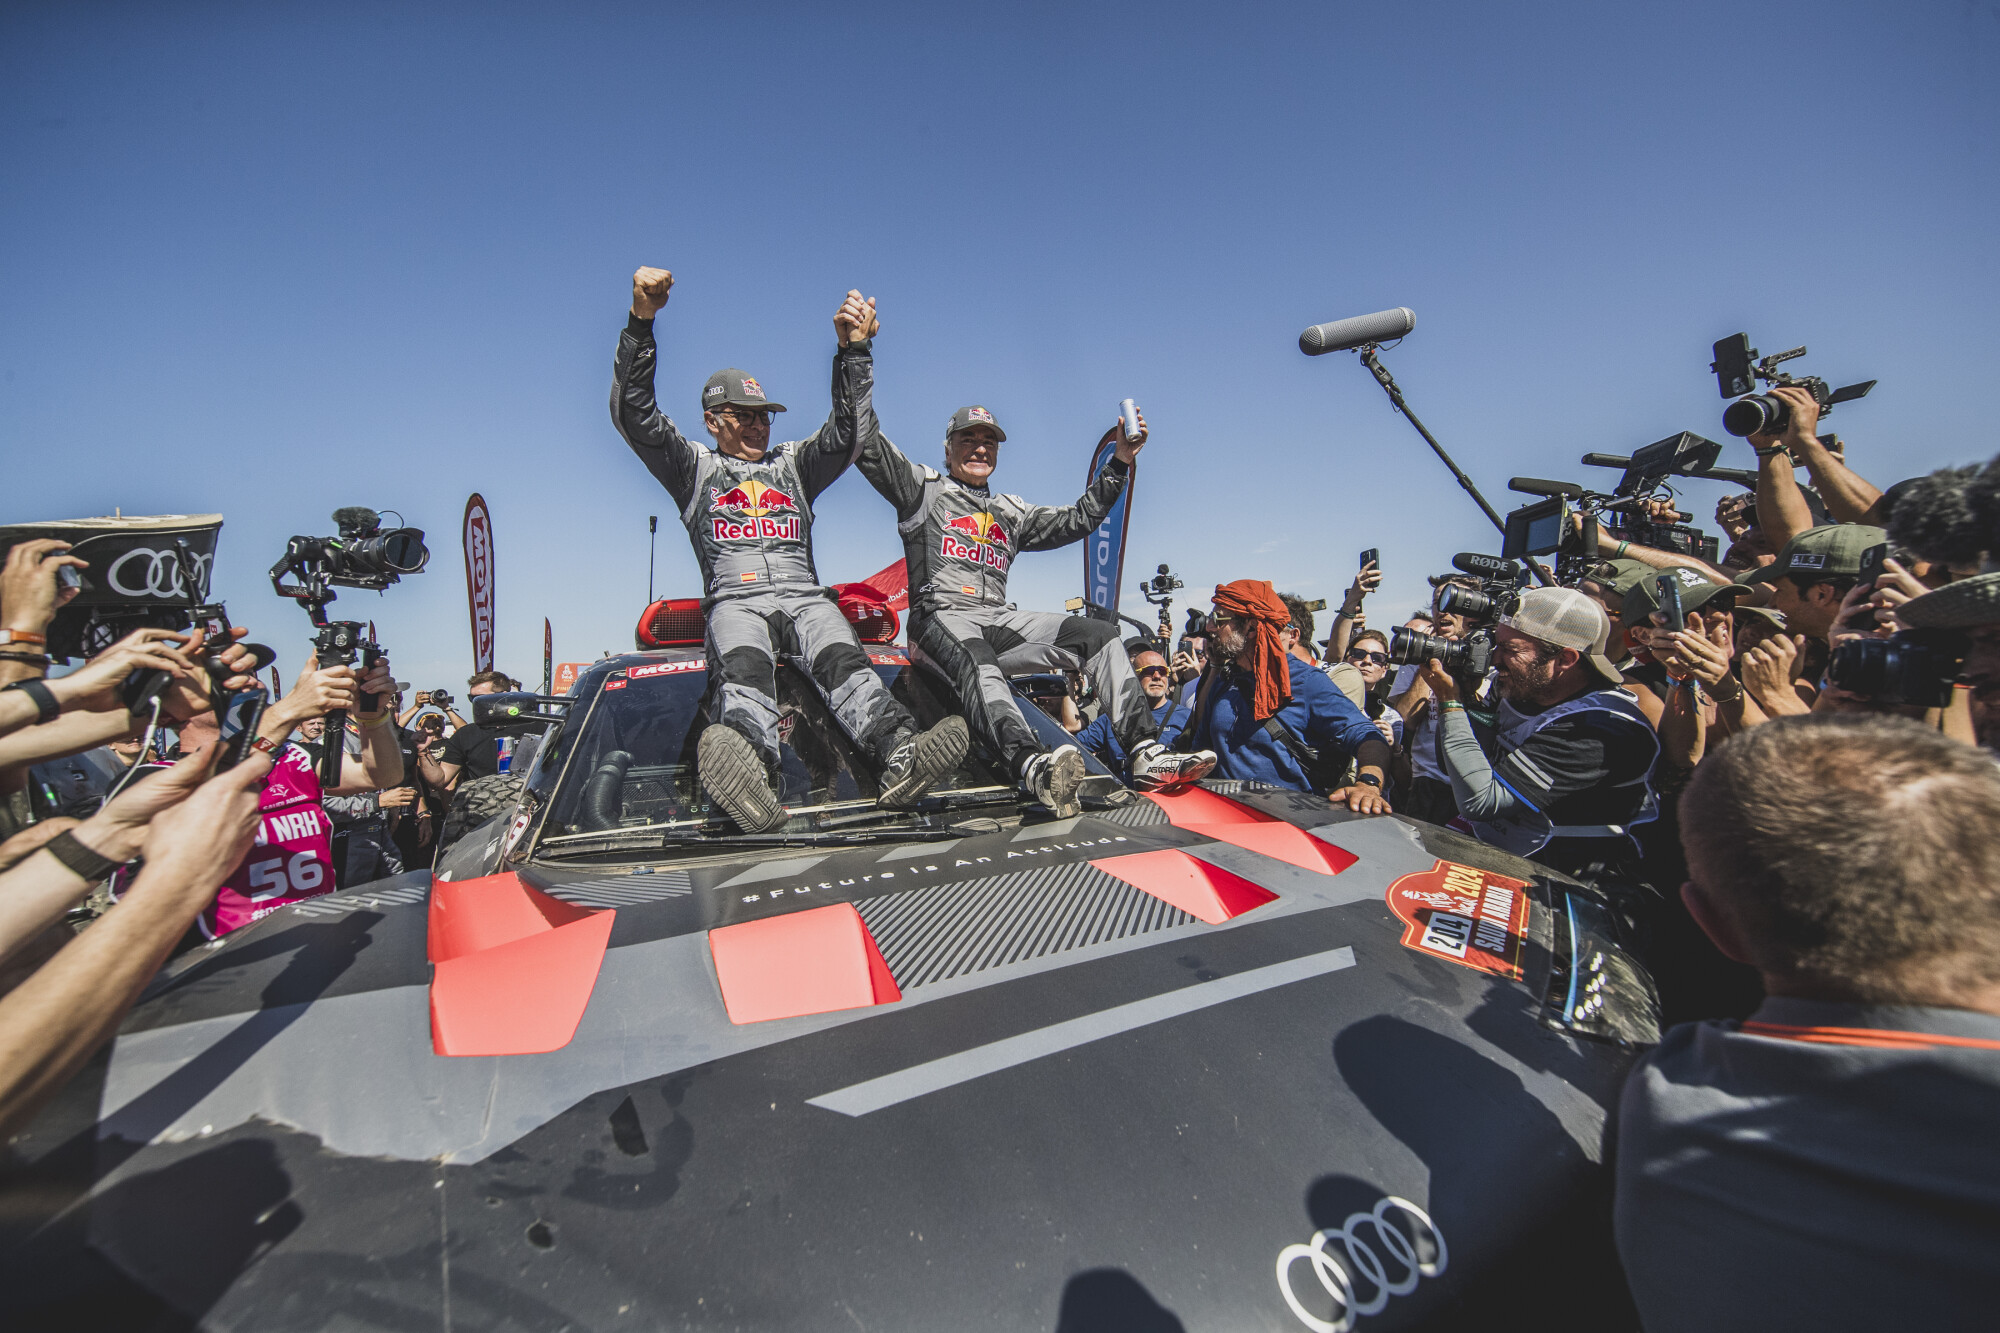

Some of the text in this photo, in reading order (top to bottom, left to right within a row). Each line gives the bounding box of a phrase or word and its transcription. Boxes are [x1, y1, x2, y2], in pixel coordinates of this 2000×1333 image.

[713, 518, 799, 540] Red Bull
[942, 536, 1009, 573] Red Bull
[1470, 555, 1509, 571] RØDE
[472, 520, 490, 655] MOTUL
[635, 660, 704, 676] MOTU
[270, 810, 322, 842] NRH
[249, 850, 323, 904] 56
[742, 836, 1127, 903] #Future Is An Attitude
[1442, 865, 1485, 898] 2024
[1427, 917, 1469, 950] 204
[1474, 885, 1514, 952] SAUDI ARABIA
